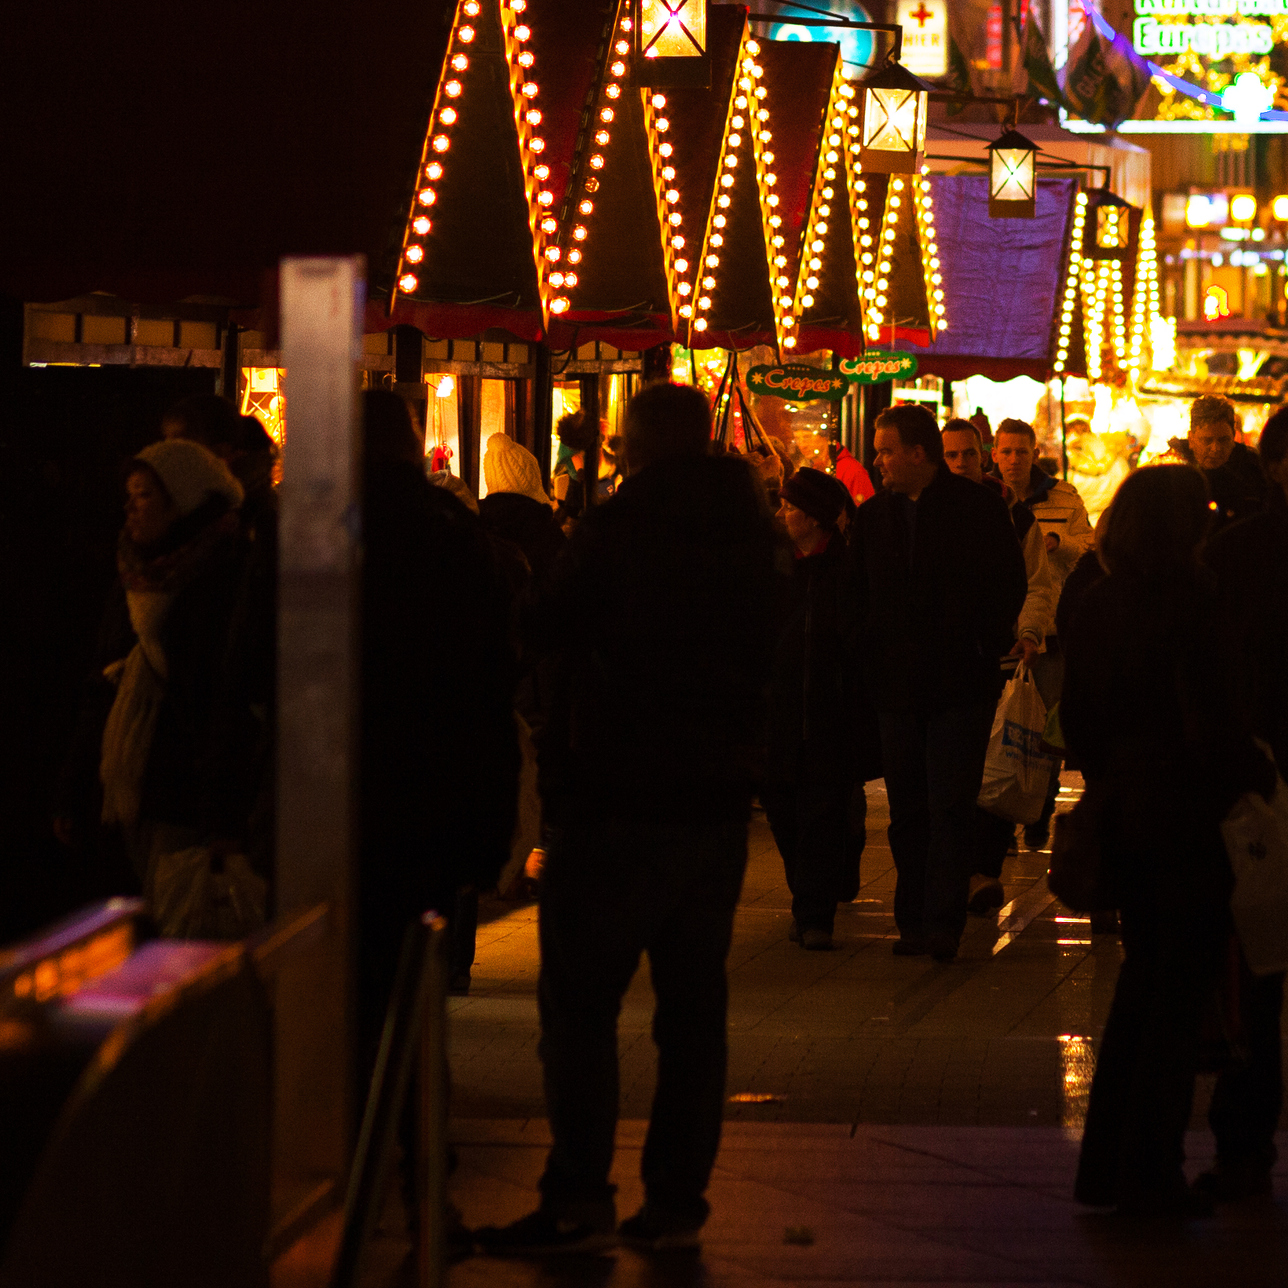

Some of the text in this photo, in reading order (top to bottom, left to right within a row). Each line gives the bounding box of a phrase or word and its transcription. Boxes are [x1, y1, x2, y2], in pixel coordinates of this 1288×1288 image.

[903, 33, 940, 47] HIER
[1133, 15, 1274, 61] Europas
[764, 369, 832, 398] Crepes
